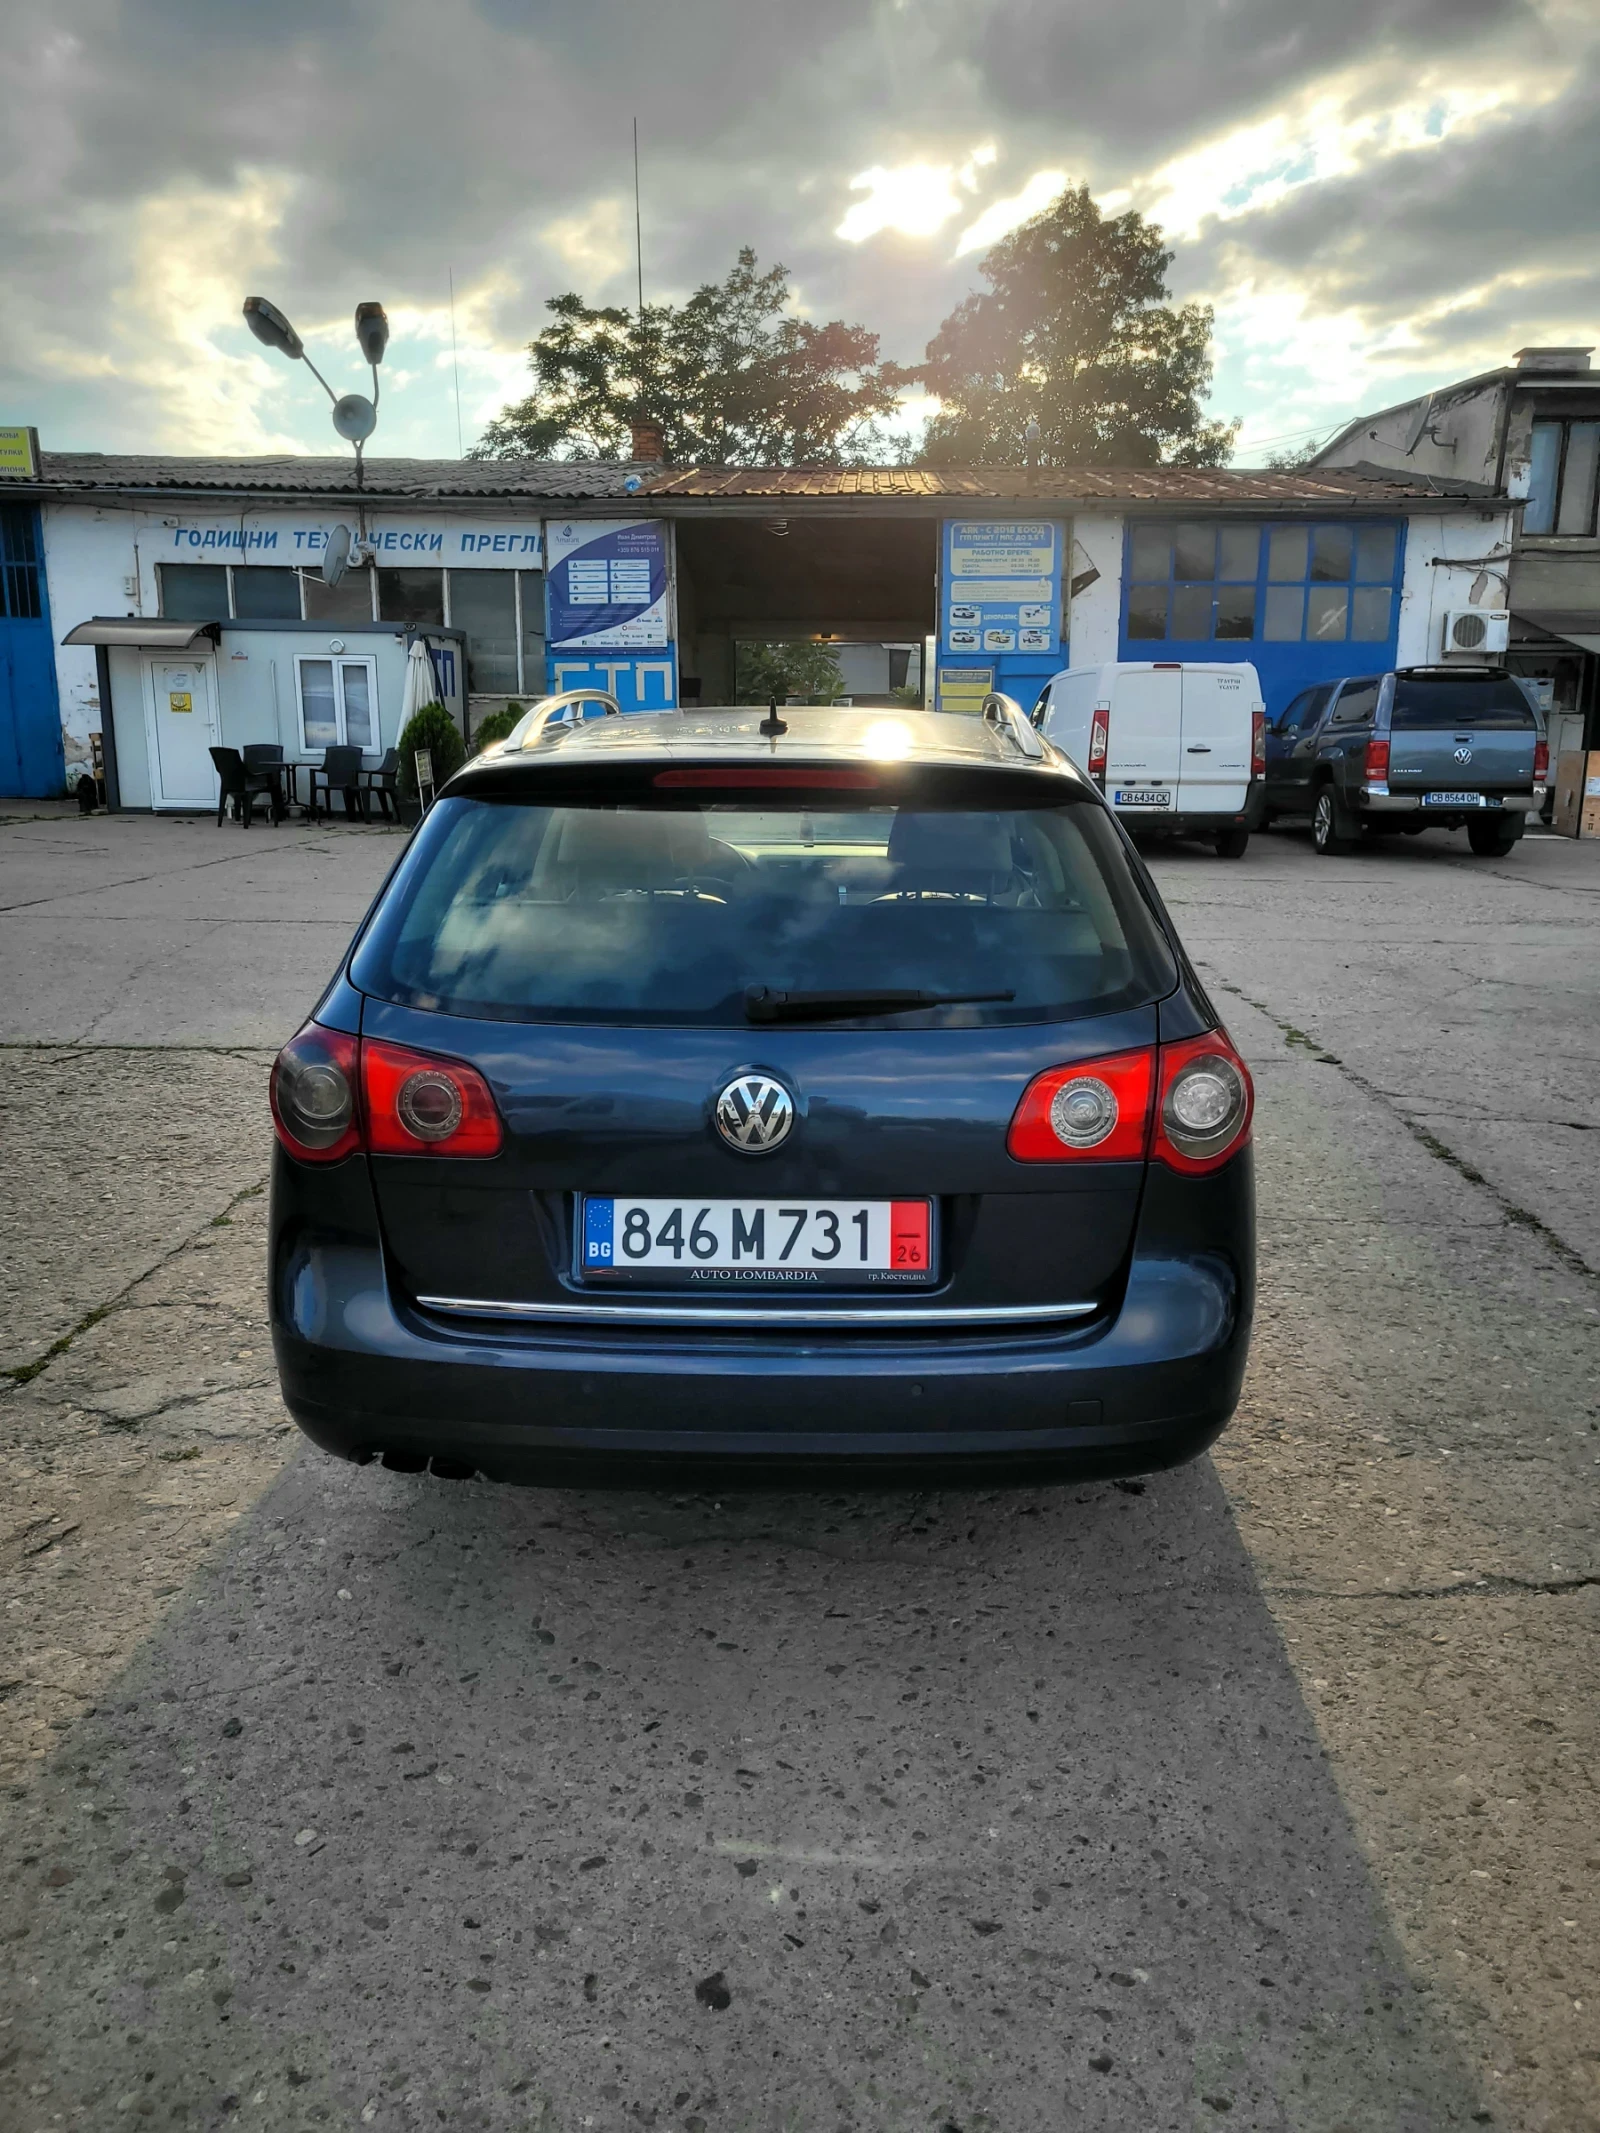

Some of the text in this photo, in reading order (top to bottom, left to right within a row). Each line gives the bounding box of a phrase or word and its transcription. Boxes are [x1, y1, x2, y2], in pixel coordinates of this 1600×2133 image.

[1017, 526, 1045, 535] ЕООД
[174, 529, 278, 549] ГОДИШНИ
[554, 662, 672, 701] ГТП
[1121, 793, 1168, 803] CB 6434 CK
[1431, 792, 1479, 803] CB 8564 OH
[621, 1207, 719, 1260] 846
[778, 1208, 869, 1261] 731
[588, 1241, 611, 1258] BG
[896, 1245, 921, 1263] 26
[690, 1270, 818, 1281] AUTO LOMBARDIA
[868, 1273, 880, 1281] гр.
